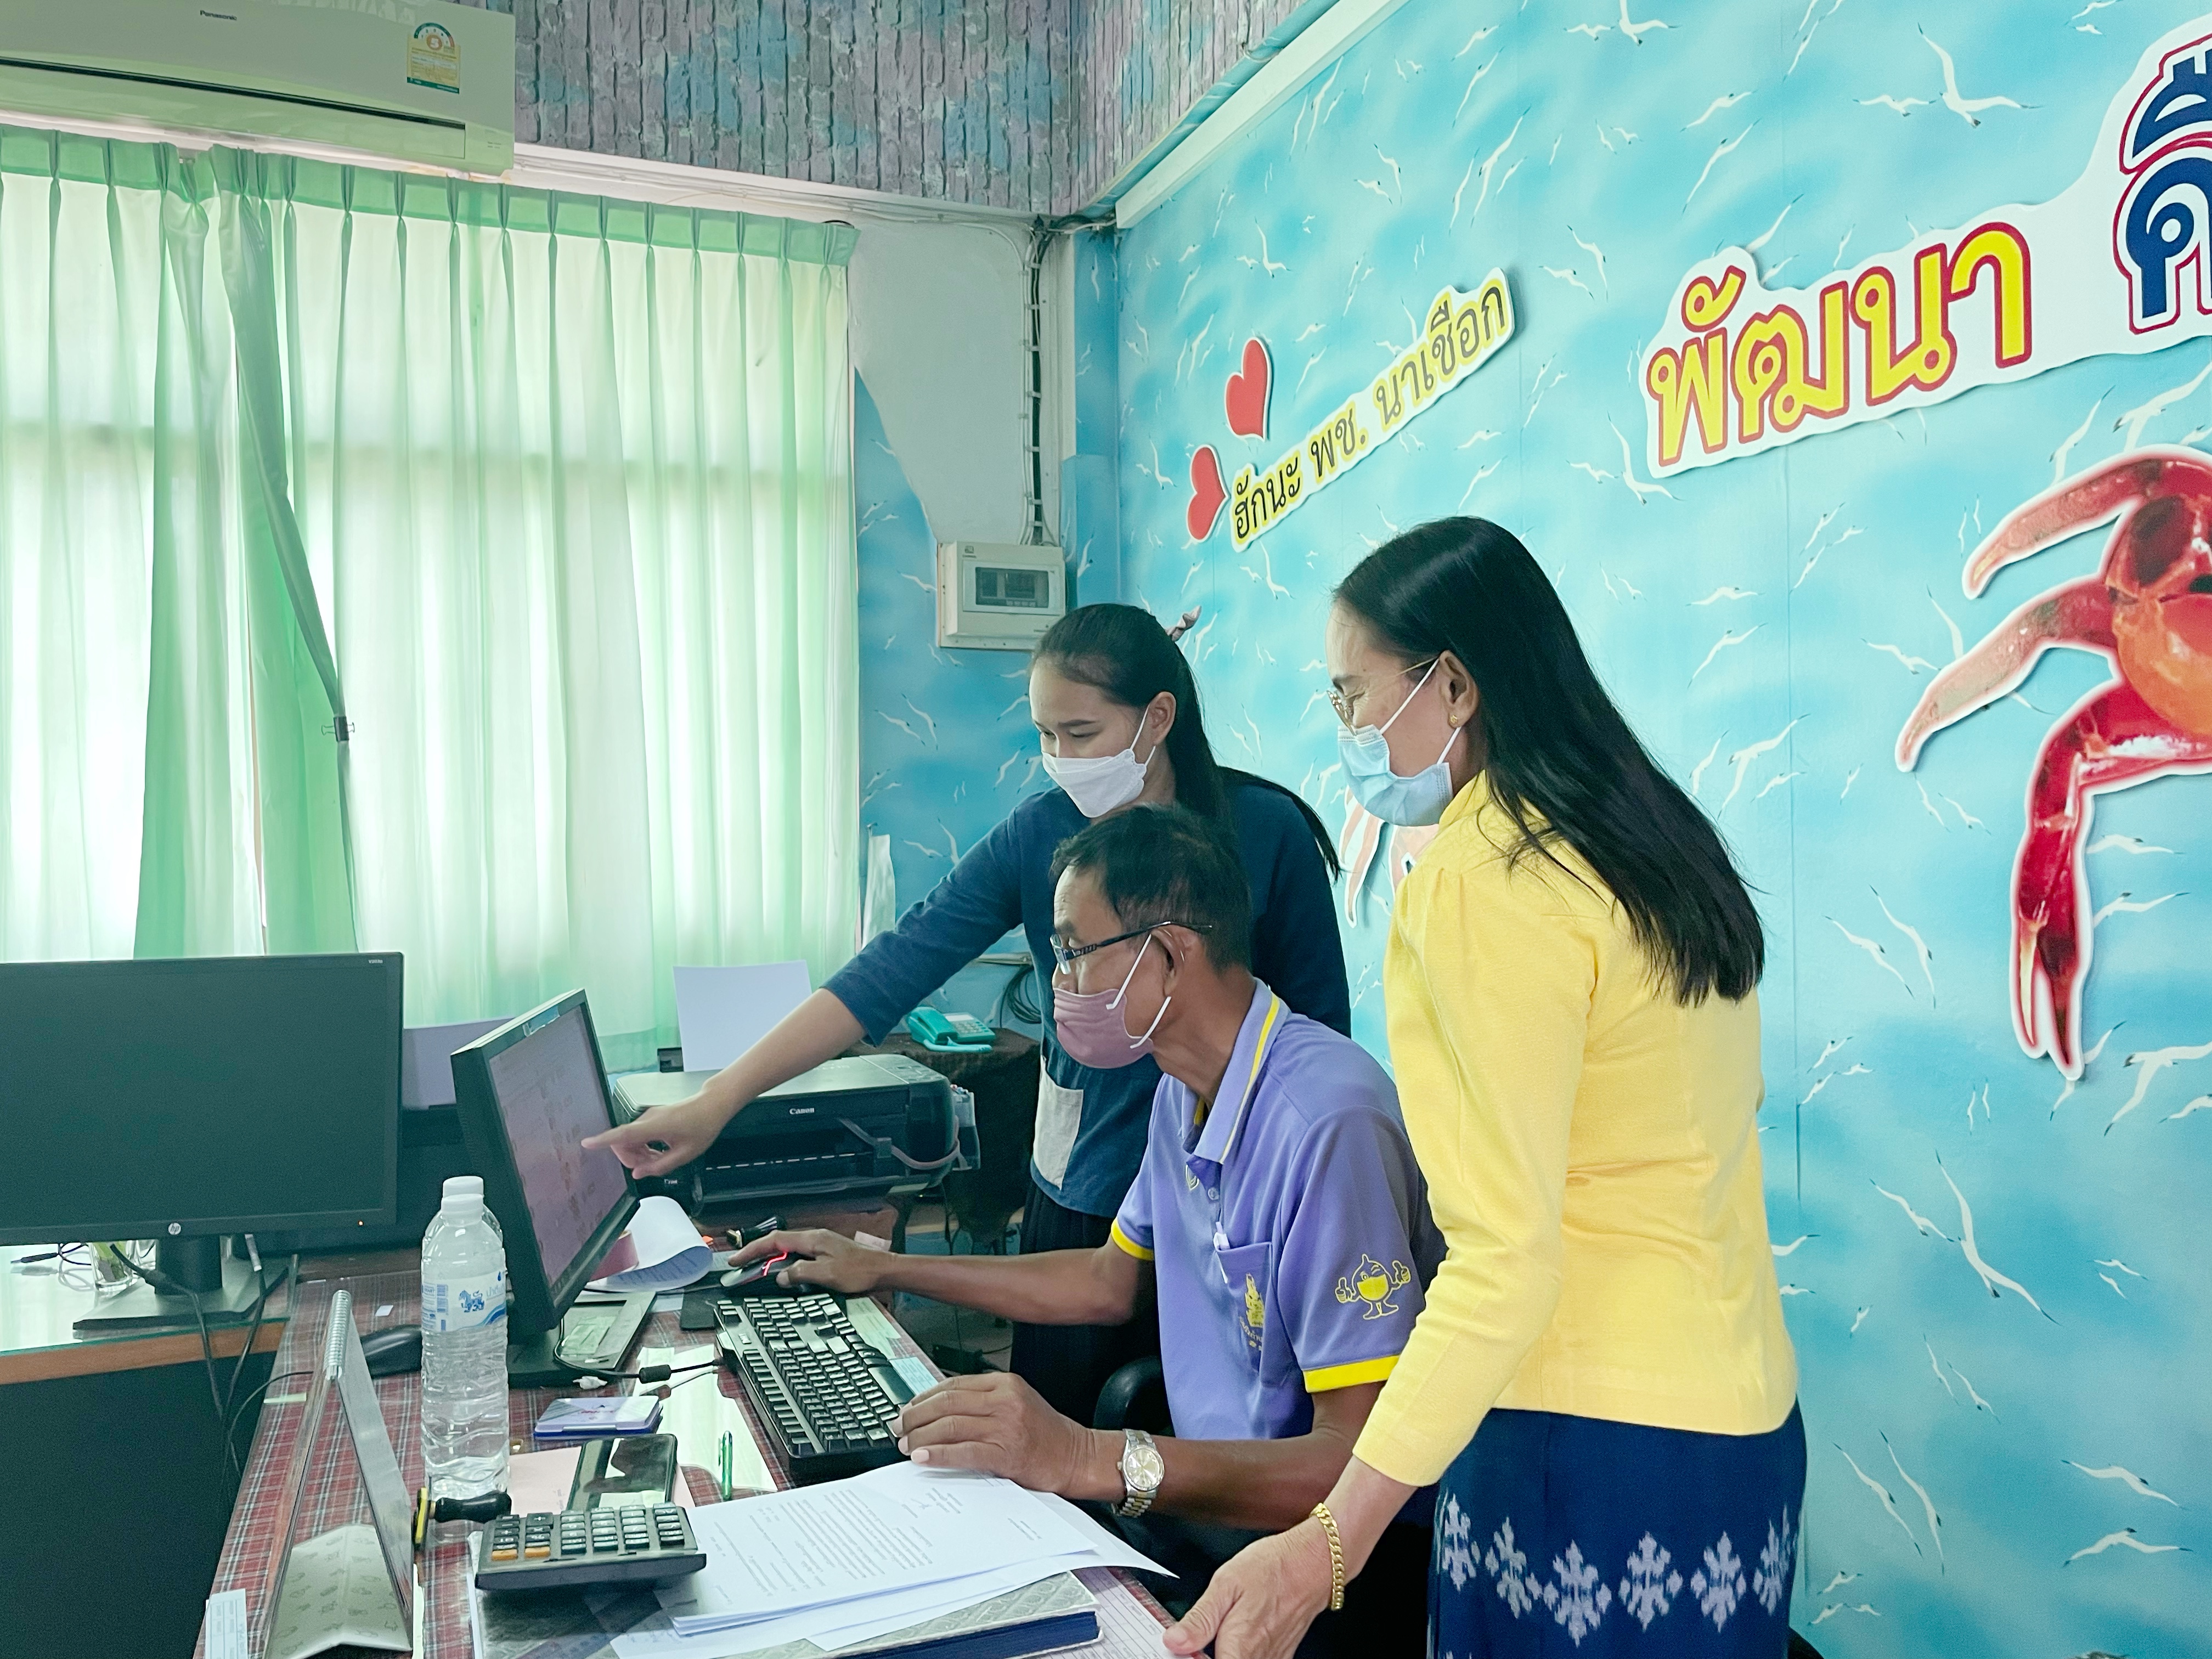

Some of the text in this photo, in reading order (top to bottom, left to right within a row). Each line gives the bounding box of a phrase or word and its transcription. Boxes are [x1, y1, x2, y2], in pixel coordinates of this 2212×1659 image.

[200, 9, 237, 21] Panasonic
[1647, 222, 2032, 466] พัฒนา
[1234, 286, 1505, 539] ฮักนะ พช. นาเชือก
[170, 1223, 180, 1234] hp
